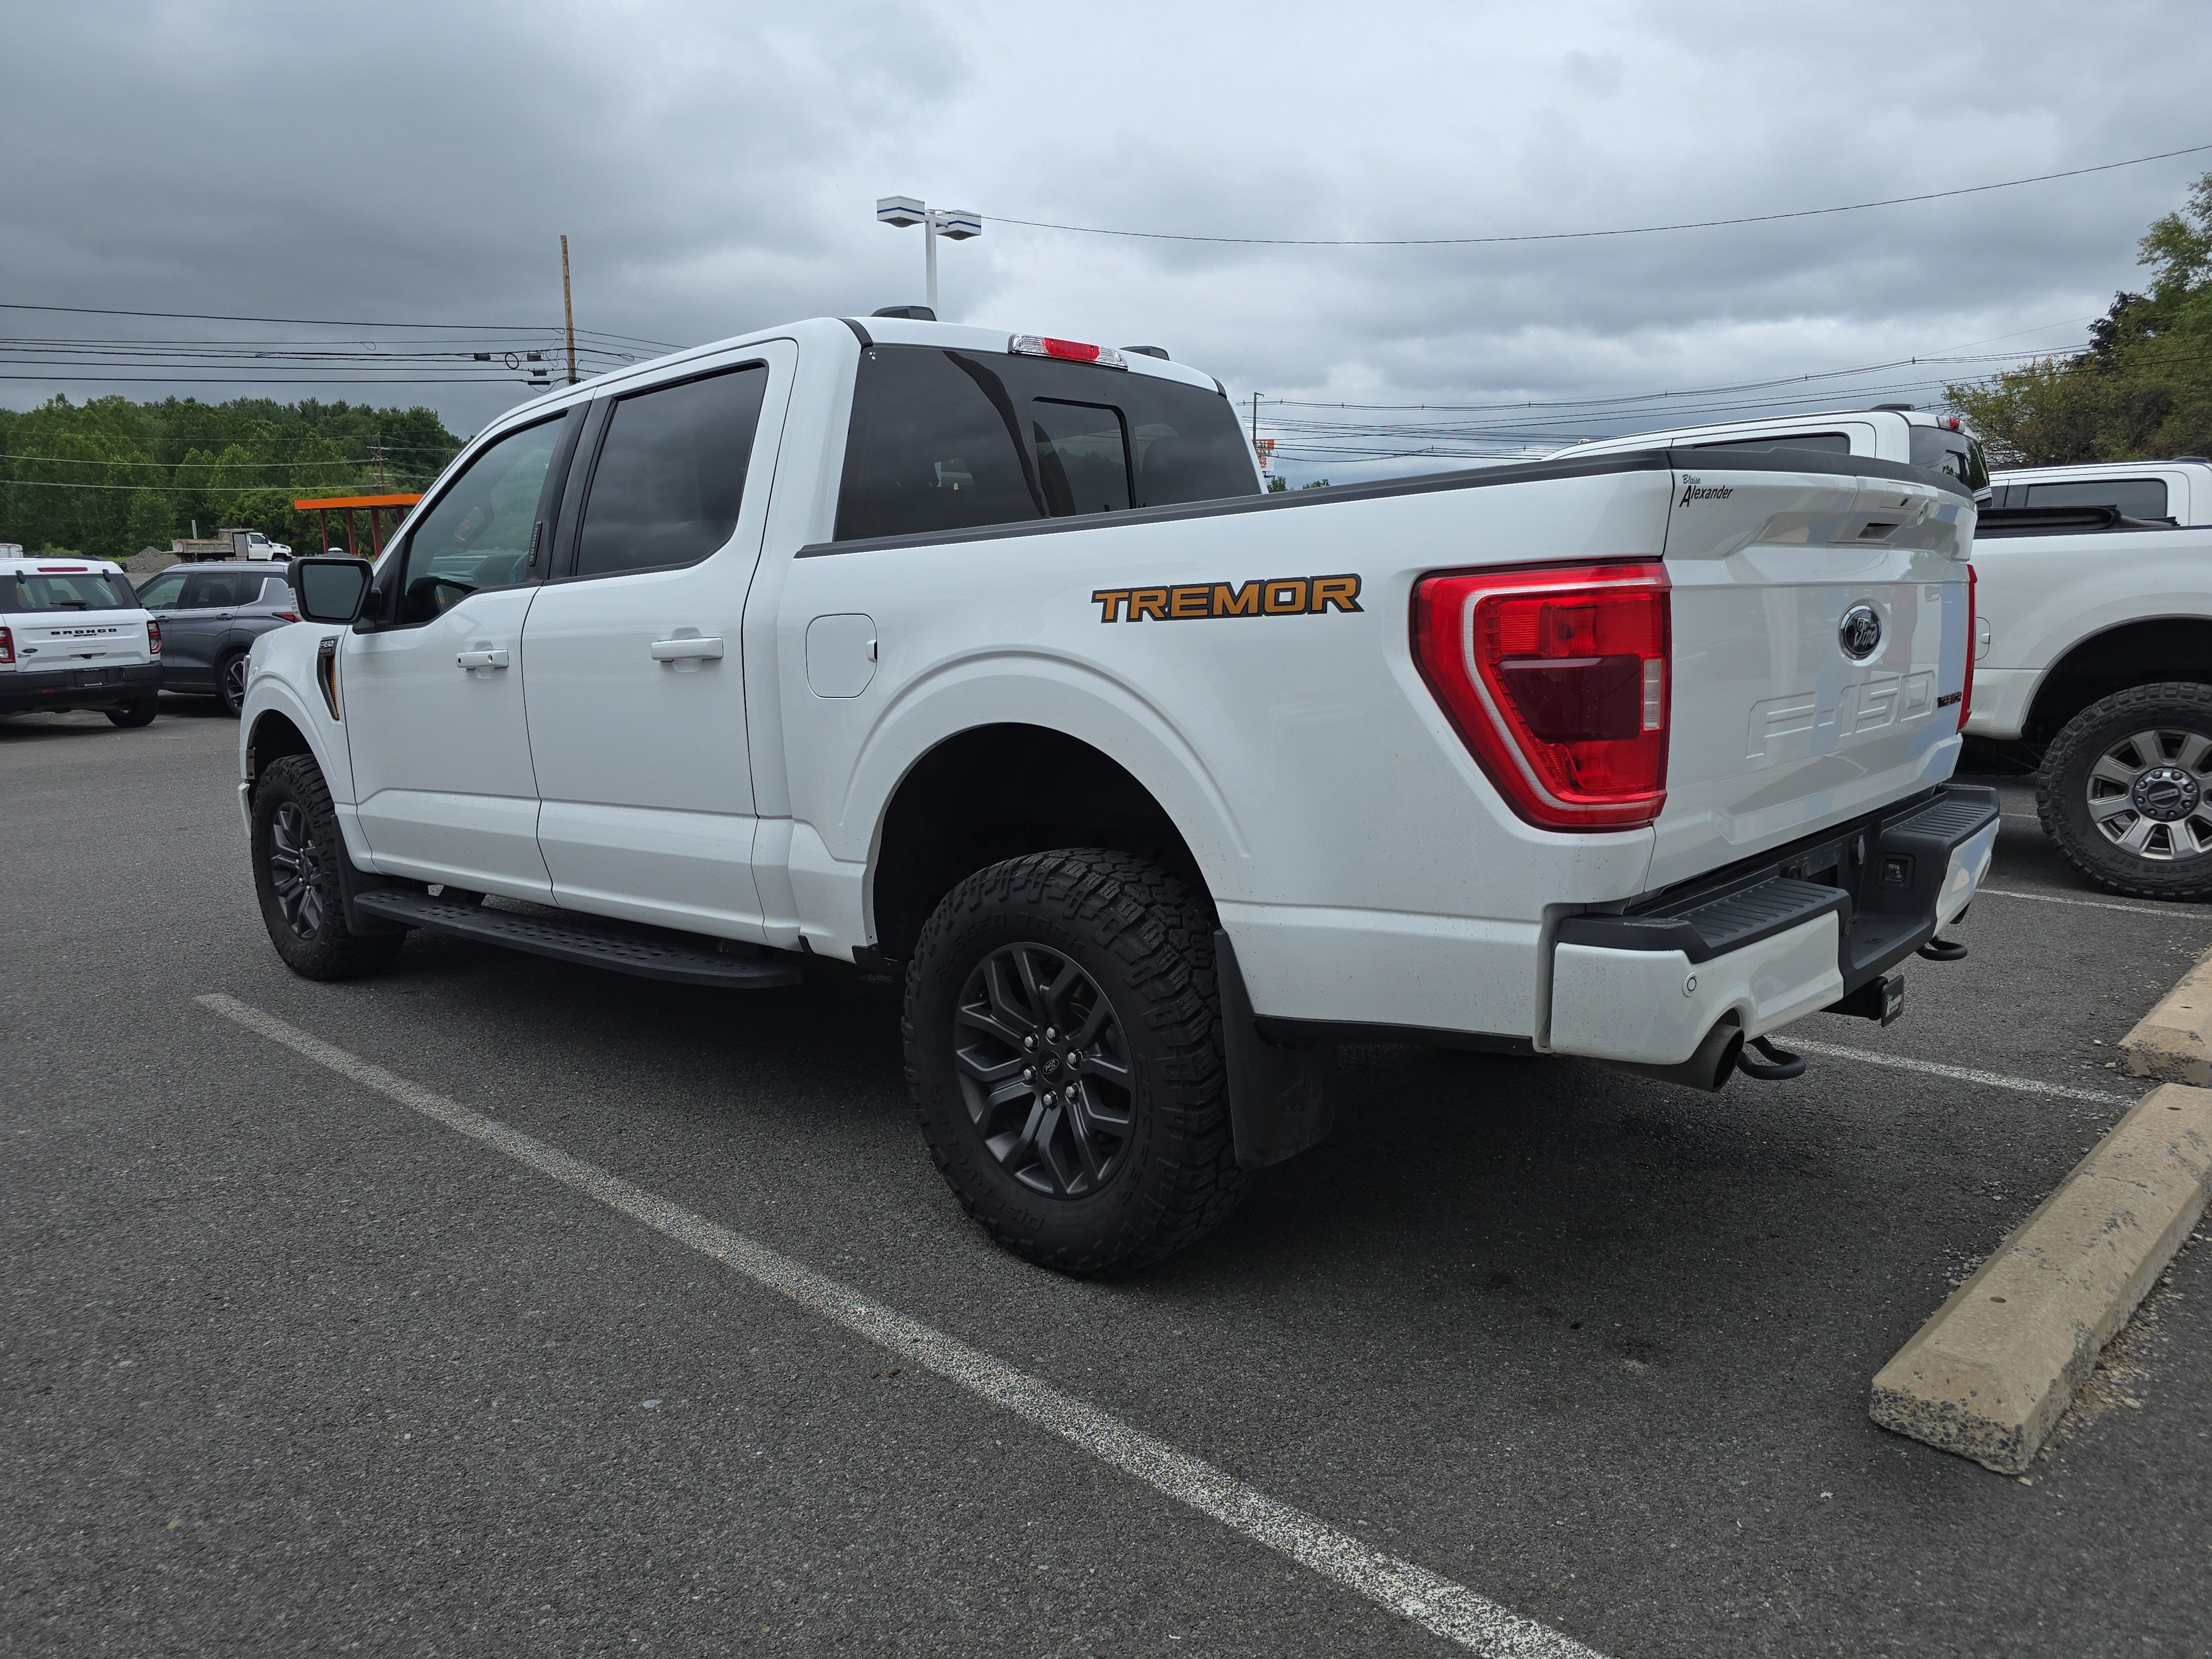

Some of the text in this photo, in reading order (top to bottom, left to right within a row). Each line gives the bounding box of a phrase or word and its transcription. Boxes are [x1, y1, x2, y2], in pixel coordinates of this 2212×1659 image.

[1682, 474, 1701, 484] Blaise
[1679, 485, 1734, 508] Alexander
[1091, 573, 1365, 623] TREMOR
[1854, 616, 1876, 647] Ford
[1745, 669, 1935, 760] F-150
[1015, 911, 1086, 948] TREK
